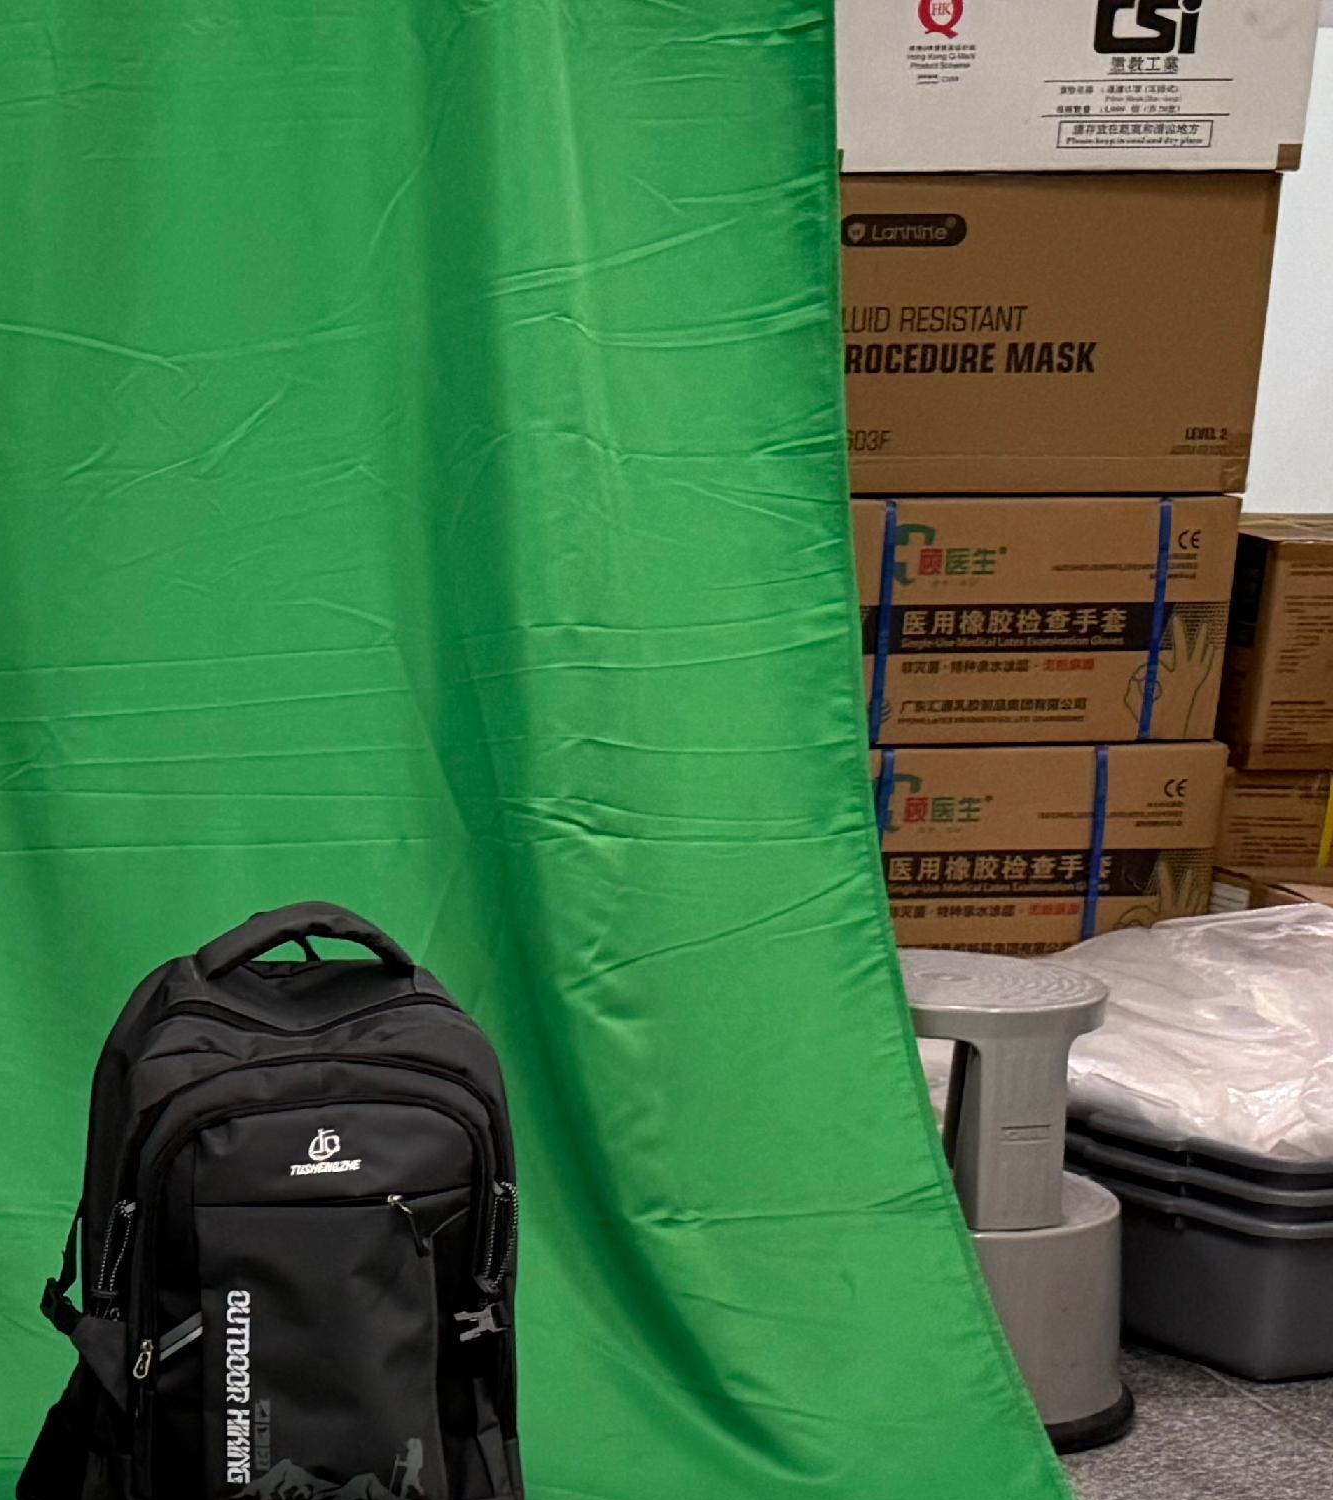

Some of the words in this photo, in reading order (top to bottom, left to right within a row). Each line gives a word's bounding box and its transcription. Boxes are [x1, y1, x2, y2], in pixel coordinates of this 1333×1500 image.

[899, 305, 1028, 333] RESISTANT
[1004, 341, 1098, 374] MASK
[1185, 427, 1217, 440] LEVEL
[901, 608, 1127, 635] 医用橡胶检查手套
[226, 1290, 251, 1404] OUTDOOR
[226, 1408, 251, 1484] HIKING
